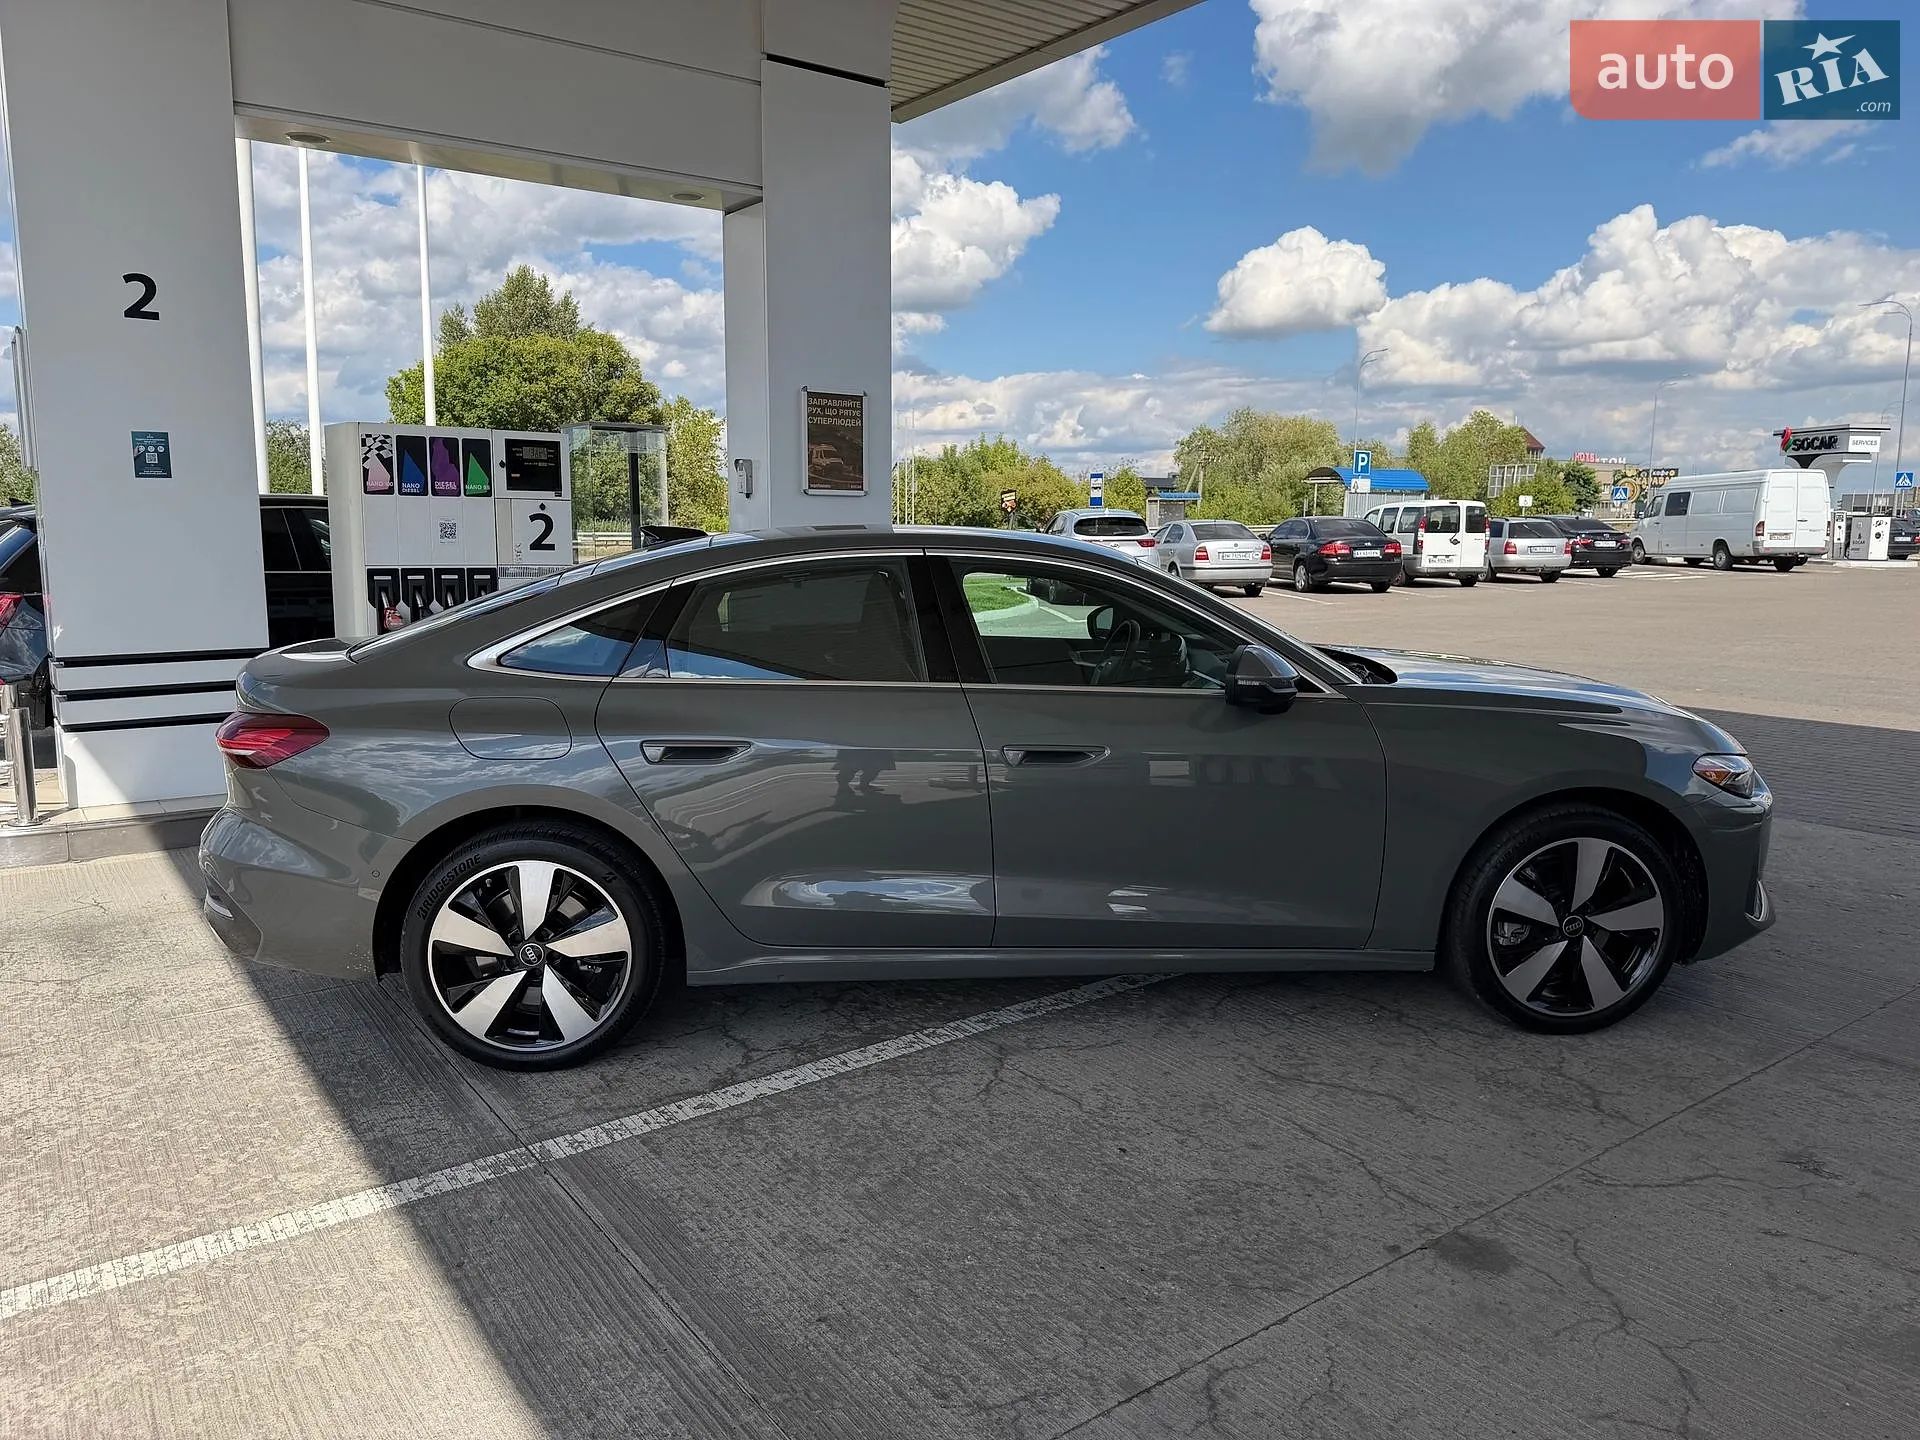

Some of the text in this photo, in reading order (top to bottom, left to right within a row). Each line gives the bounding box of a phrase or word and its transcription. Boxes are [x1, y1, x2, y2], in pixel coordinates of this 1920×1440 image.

[122, 272, 160, 321] 2
[807, 397, 862, 409] ЗАПРАВЛЯЙТЕ
[825, 408, 838, 416] ЩО
[839, 409, 862, 417] РЯТУЄ
[807, 416, 862, 427] СУПЕРЛЮДЕЙ
[1791, 435, 1838, 451] SOCAR
[1358, 454, 1368, 472] P
[529, 513, 556, 551] 2
[416, 853, 481, 921] BRIDGESTONE
